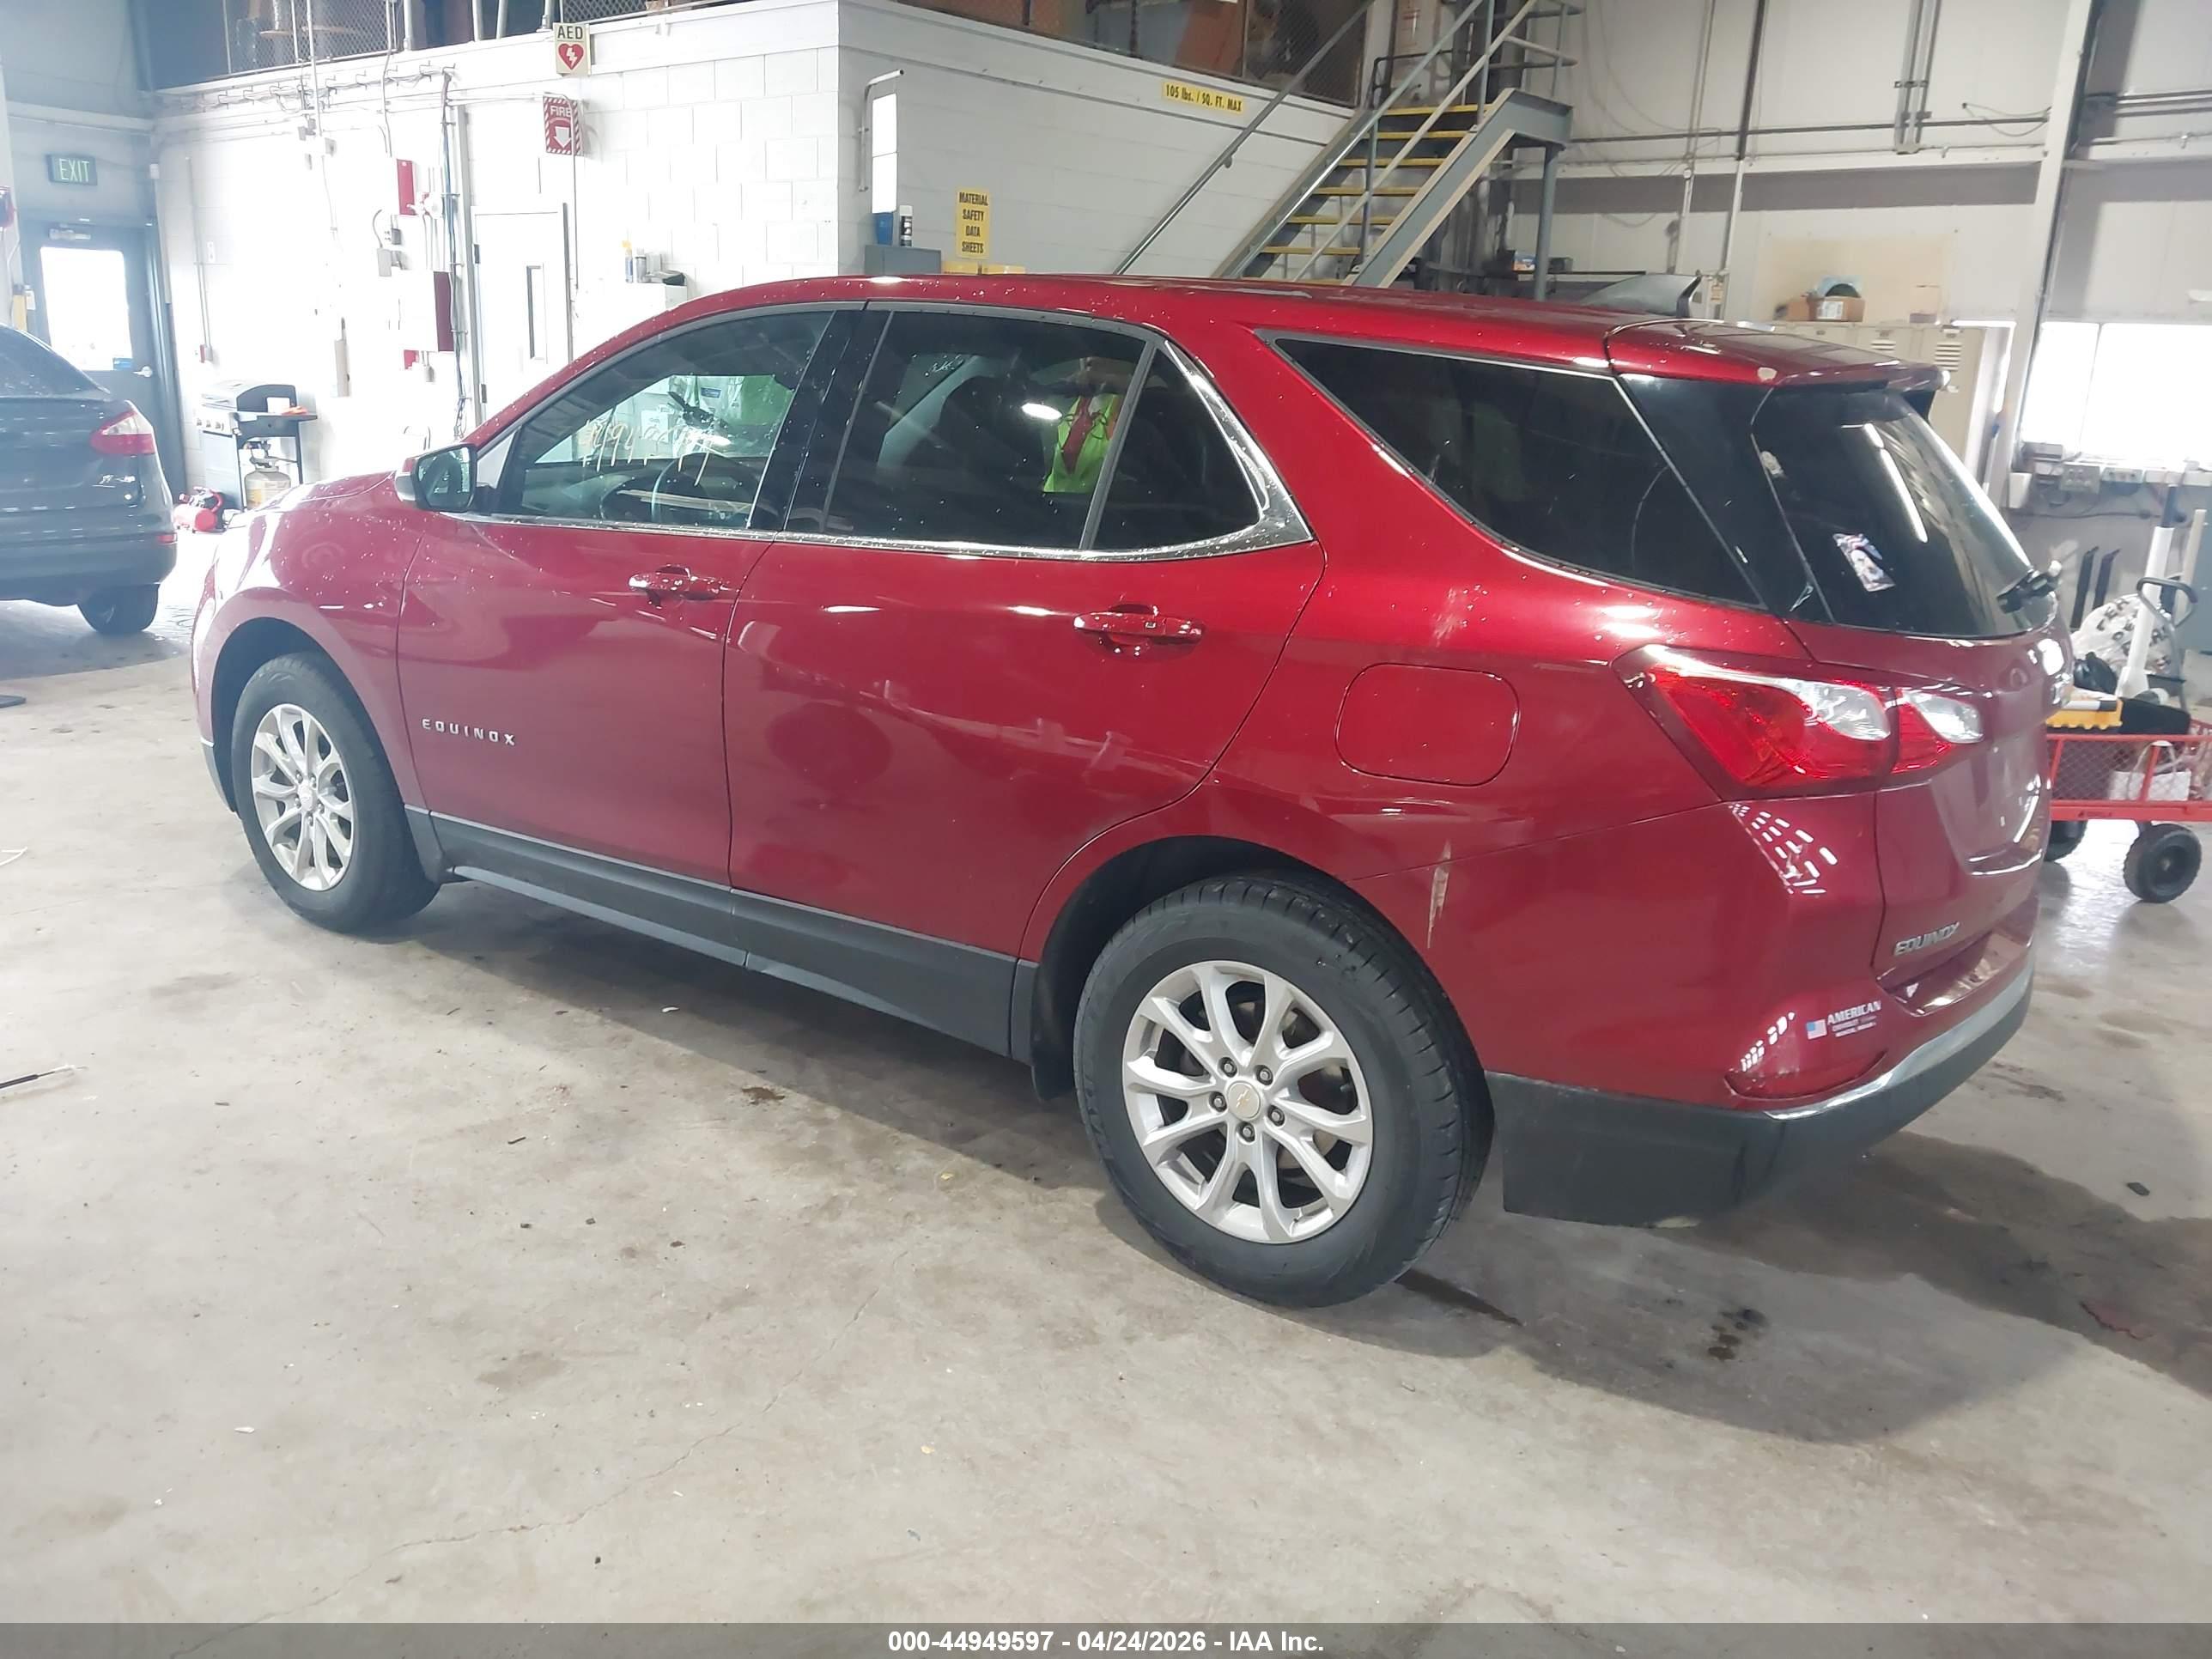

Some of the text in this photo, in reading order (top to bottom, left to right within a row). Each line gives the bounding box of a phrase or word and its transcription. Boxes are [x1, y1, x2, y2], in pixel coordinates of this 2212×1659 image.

[557, 26, 583, 40] AED
[1166, 84, 1179, 98] 105
[1182, 88, 1194, 101] lbs.
[1202, 92, 1212, 106] SQ.
[1215, 95, 1224, 108] FT.
[1227, 98, 1242, 112] MAX
[550, 105, 573, 118] FIRE
[59, 158, 90, 182] EXIT
[959, 191, 988, 206] MATERIAL
[963, 209, 984, 222] SAFETY
[965, 225, 981, 237] DATA
[962, 240, 984, 253] SHEETS
[422, 719, 515, 745] EQUINOX
[1894, 921, 1960, 956] EQUINOX
[1827, 1000, 1881, 1025] AMERICAN
